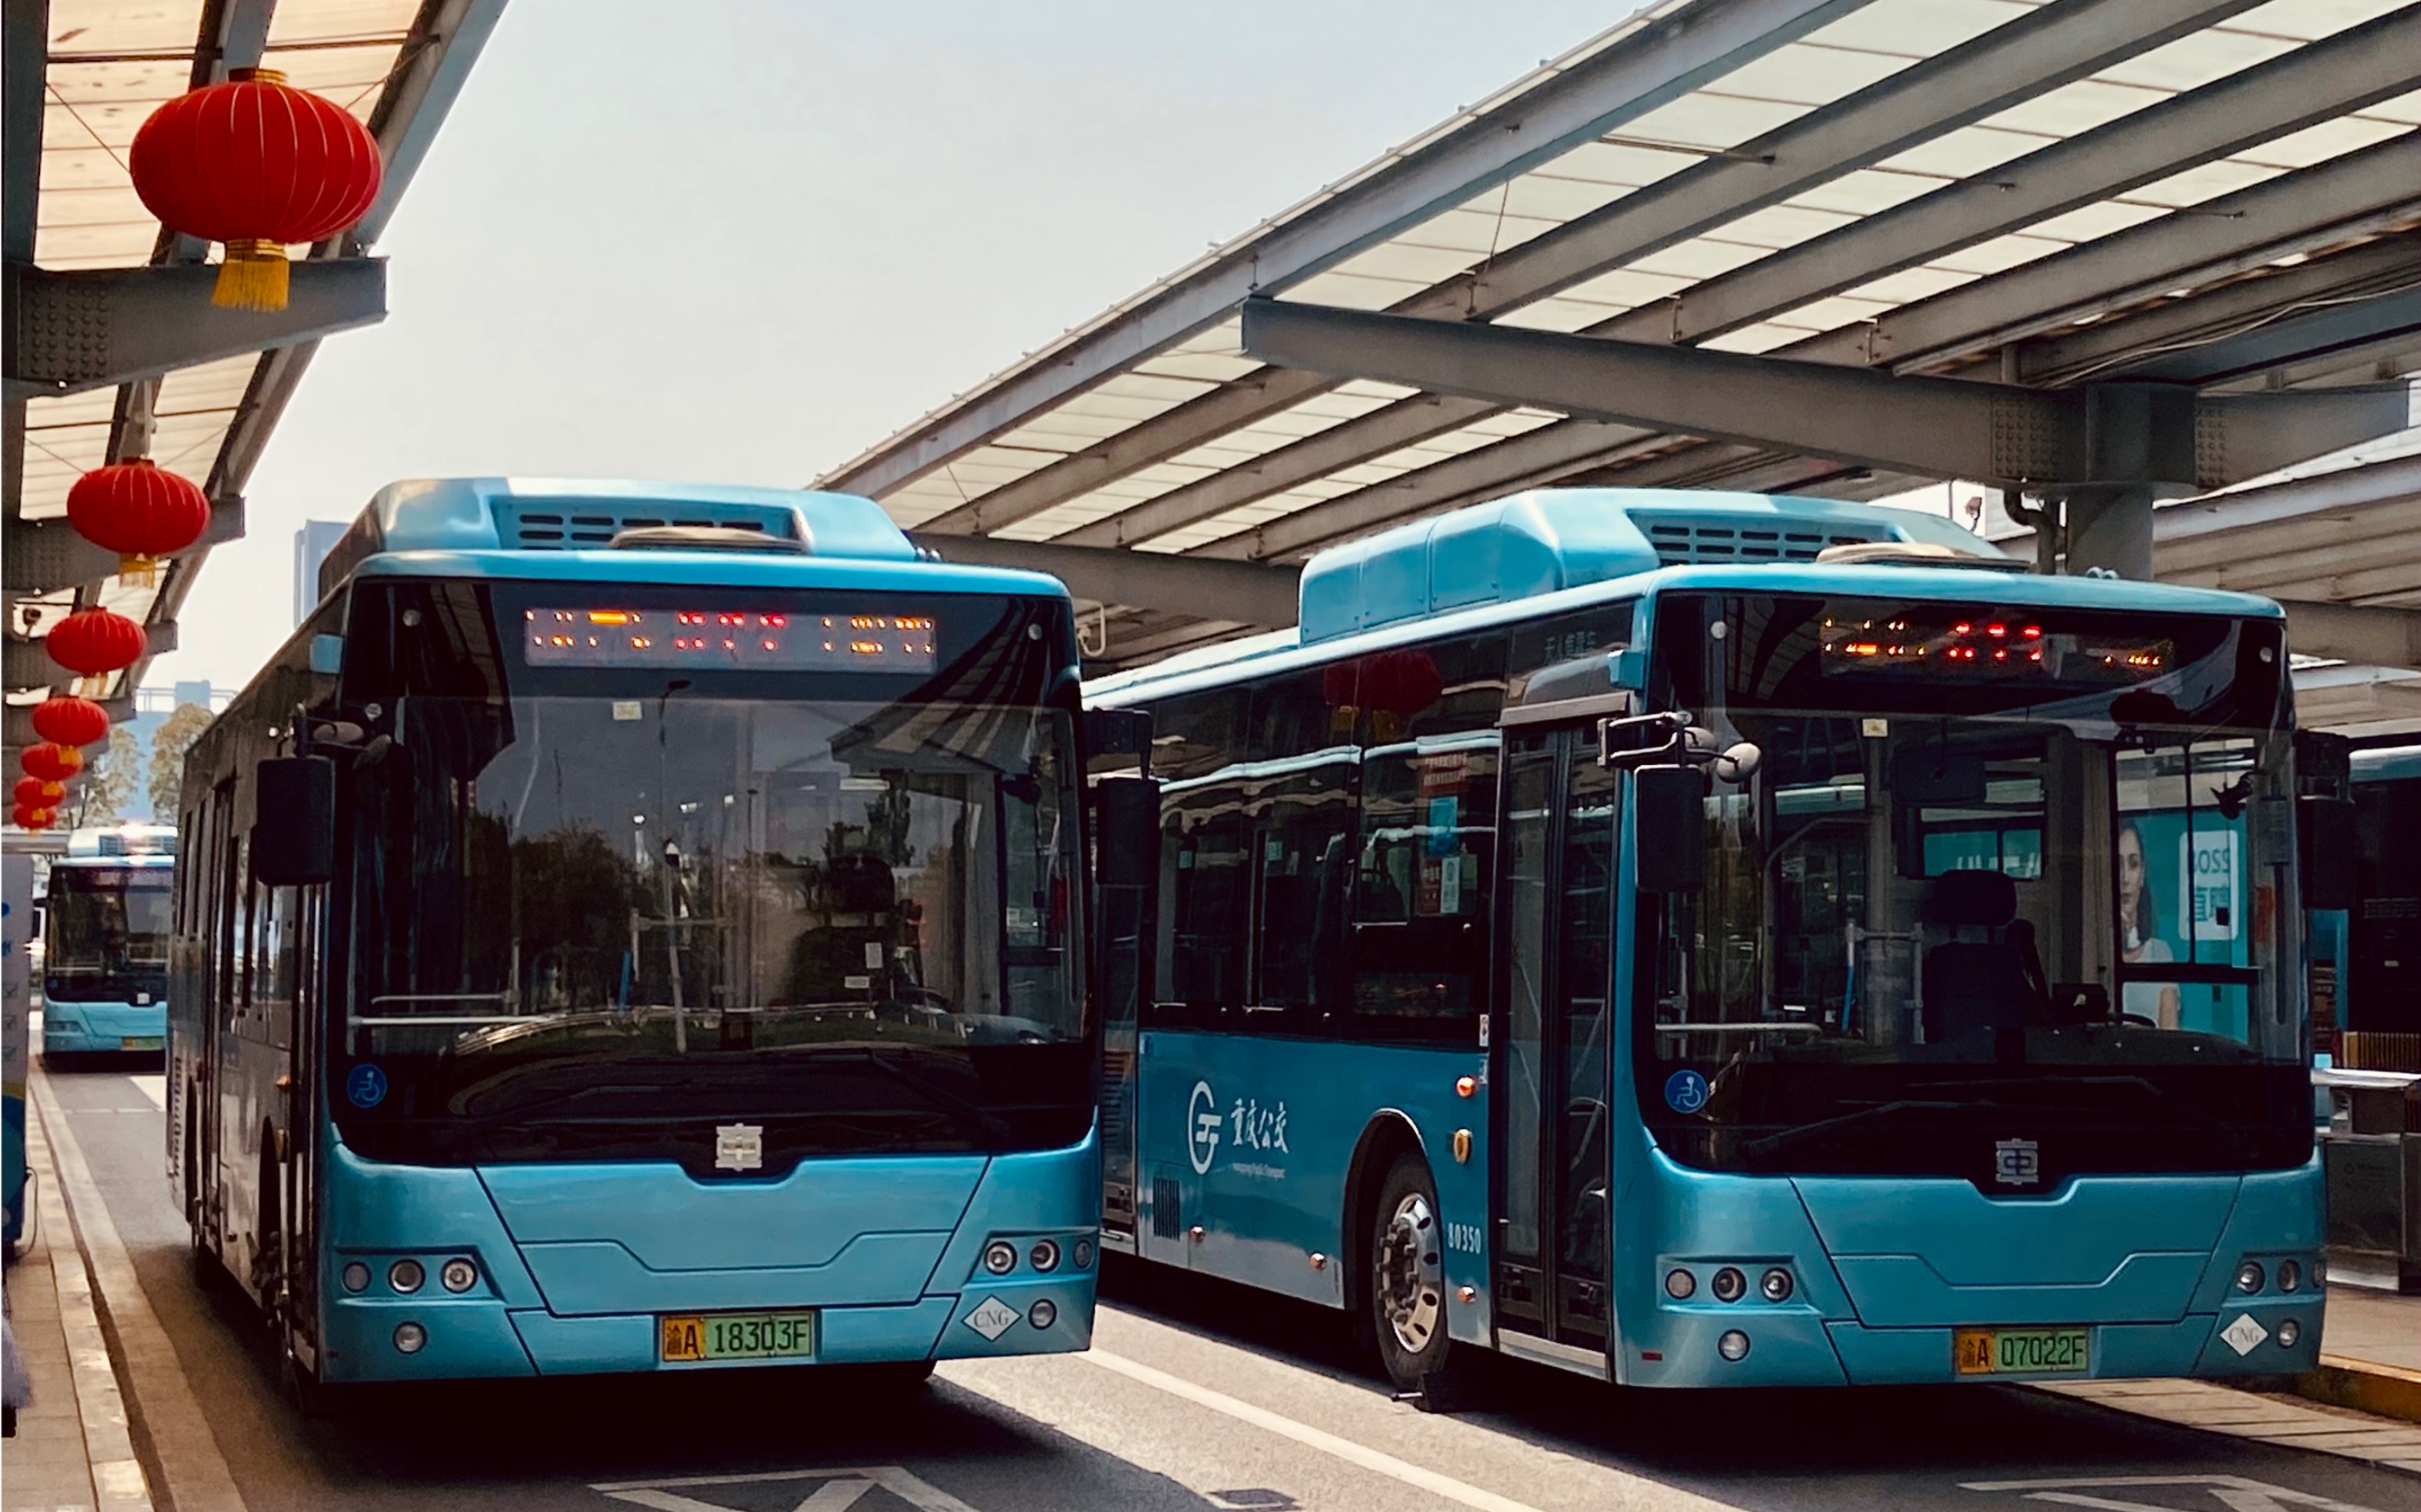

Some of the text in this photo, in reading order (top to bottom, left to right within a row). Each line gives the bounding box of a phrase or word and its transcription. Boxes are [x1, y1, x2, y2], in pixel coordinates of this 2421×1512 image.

[973, 1309, 1010, 1328] CNG
[714, 1319, 808, 1353] 18303F
[2228, 1325, 2261, 1344] CNG
[2001, 1335, 2086, 1366] 07022F
